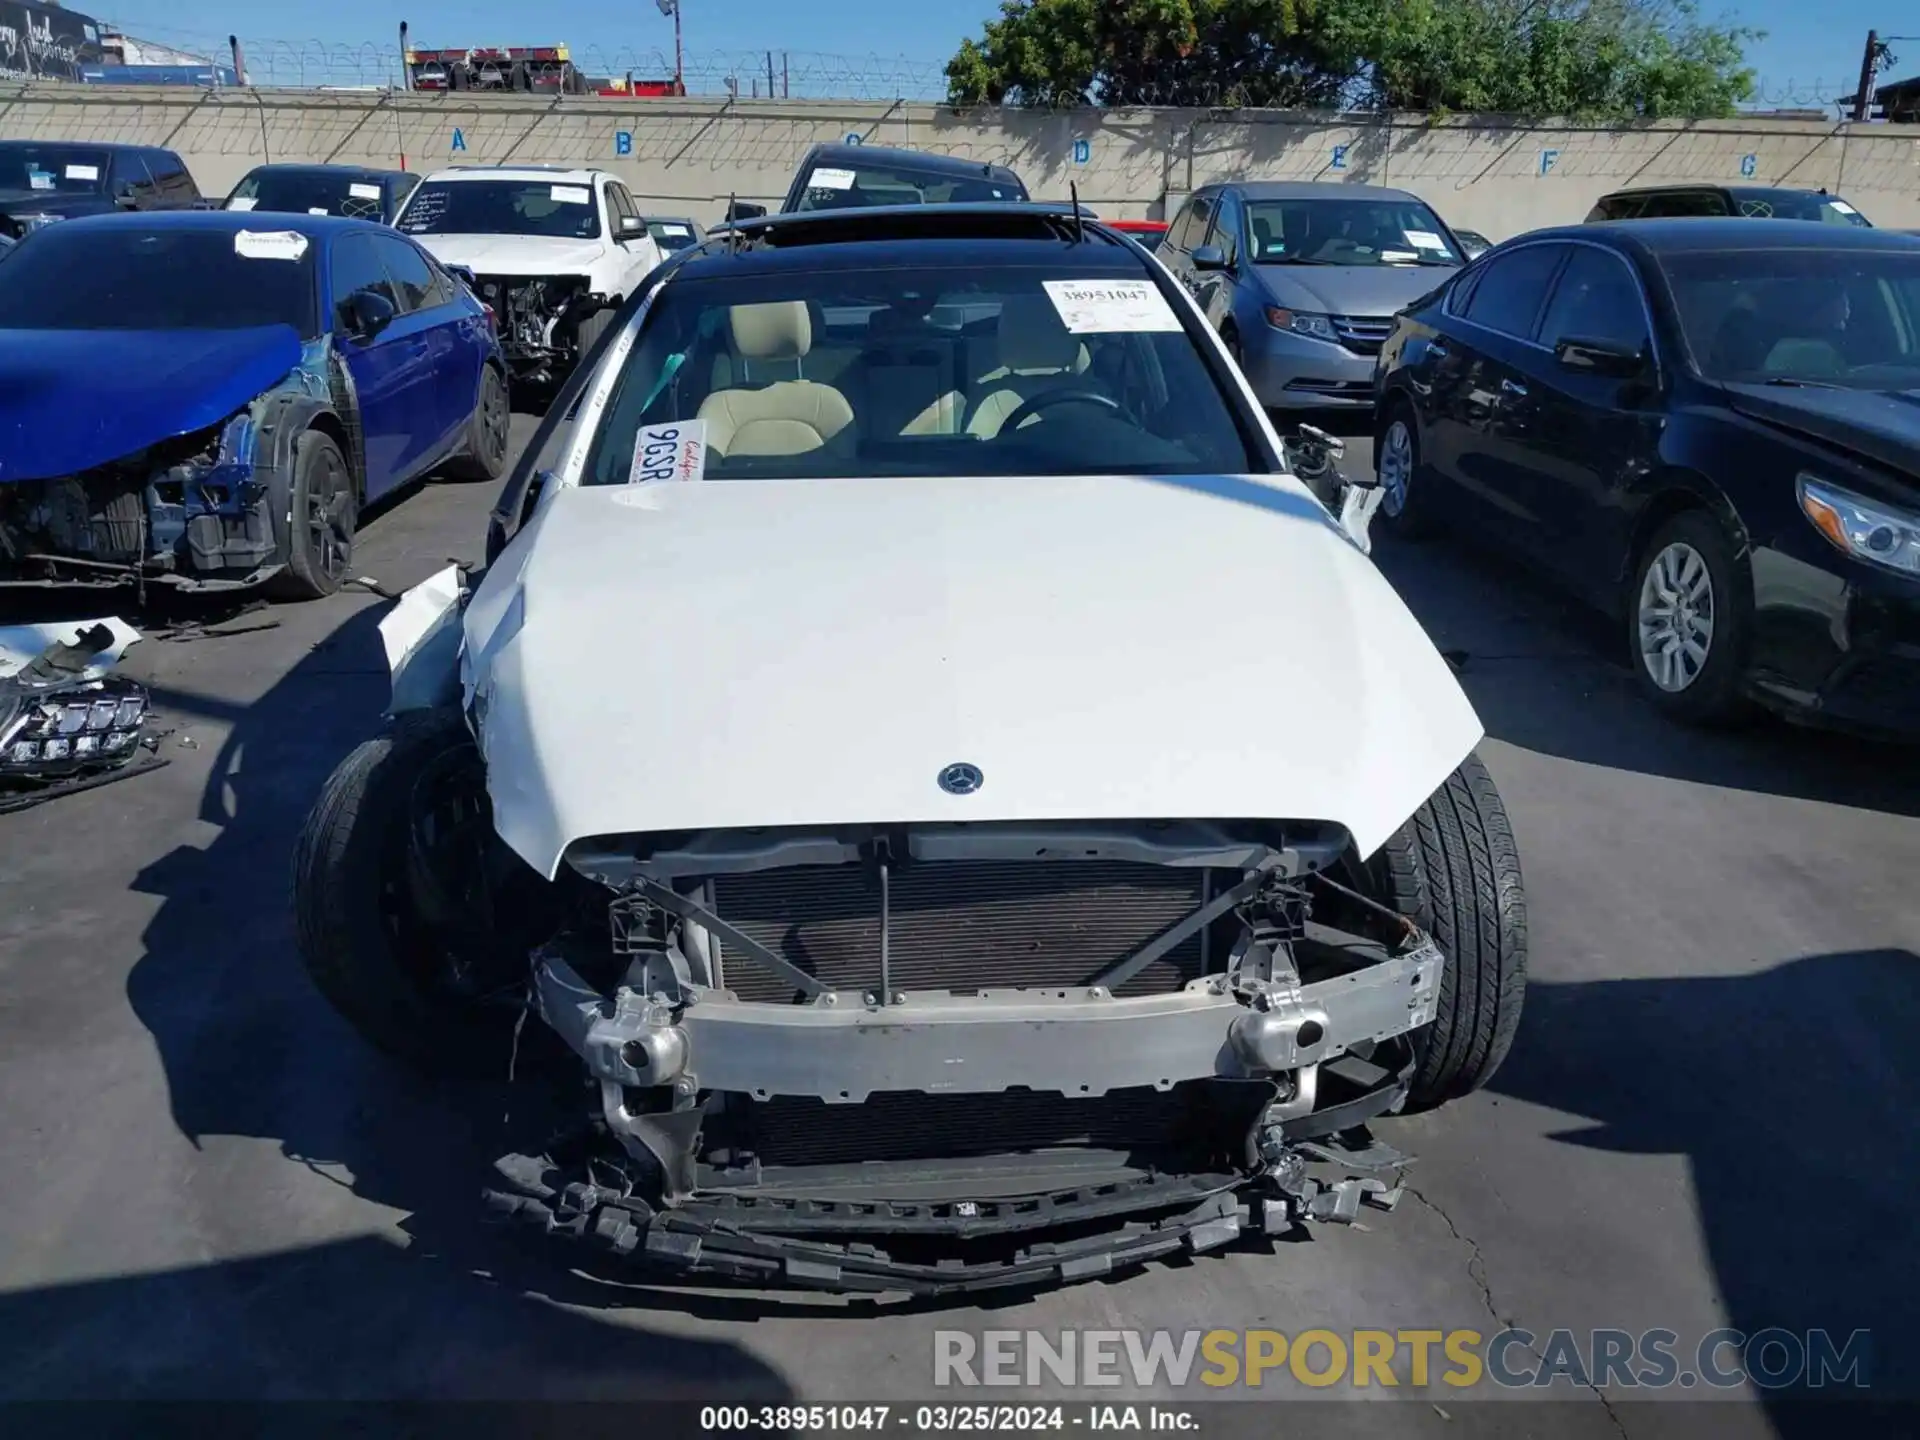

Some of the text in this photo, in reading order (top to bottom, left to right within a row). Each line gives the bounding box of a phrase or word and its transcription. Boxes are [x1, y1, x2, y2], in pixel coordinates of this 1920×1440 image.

[452, 127, 466, 151] A
[615, 131, 632, 155] B
[1074, 139, 1090, 163] D
[1332, 145, 1347, 168] E
[1542, 150, 1557, 174] F
[1741, 153, 1756, 176] G
[1062, 290, 1148, 301] 38951047
[638, 429, 680, 484] 9GSR
